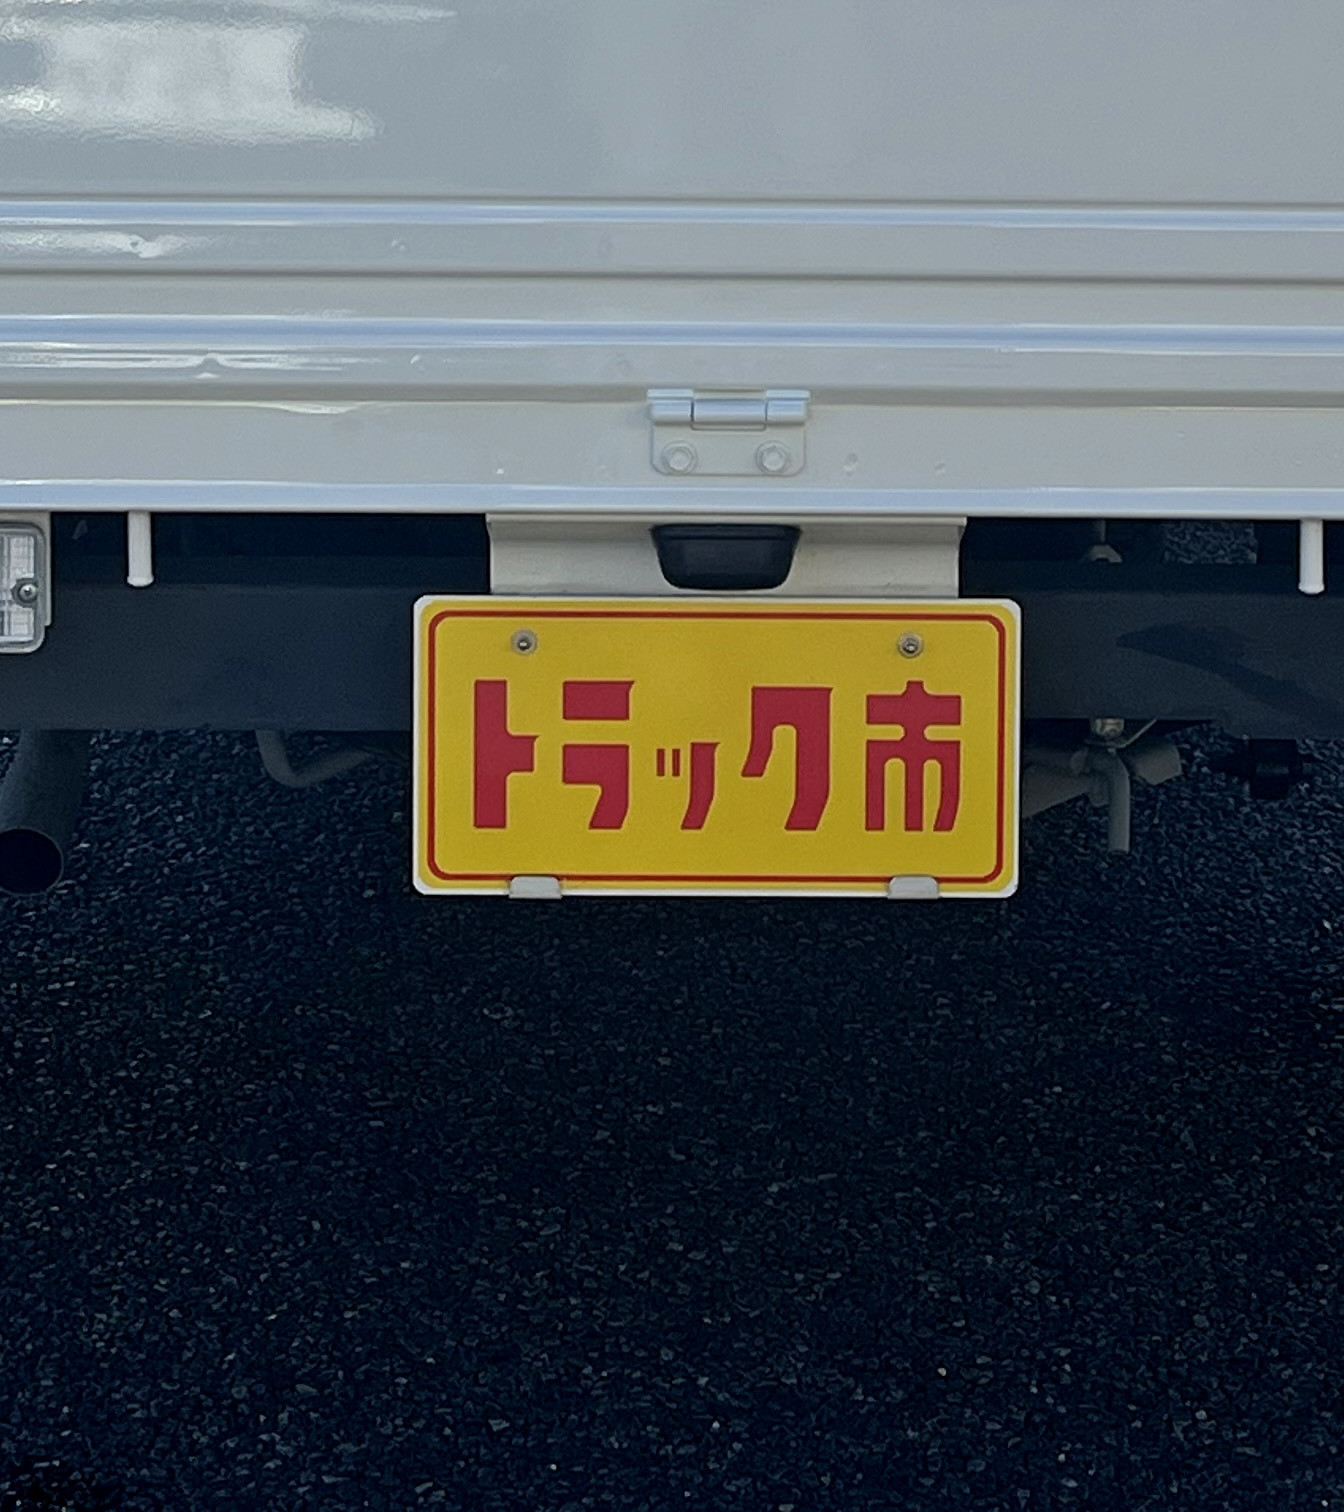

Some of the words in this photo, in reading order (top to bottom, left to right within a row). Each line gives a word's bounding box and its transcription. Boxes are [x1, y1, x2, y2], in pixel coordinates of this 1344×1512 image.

[473, 679, 962, 832] トラック市
